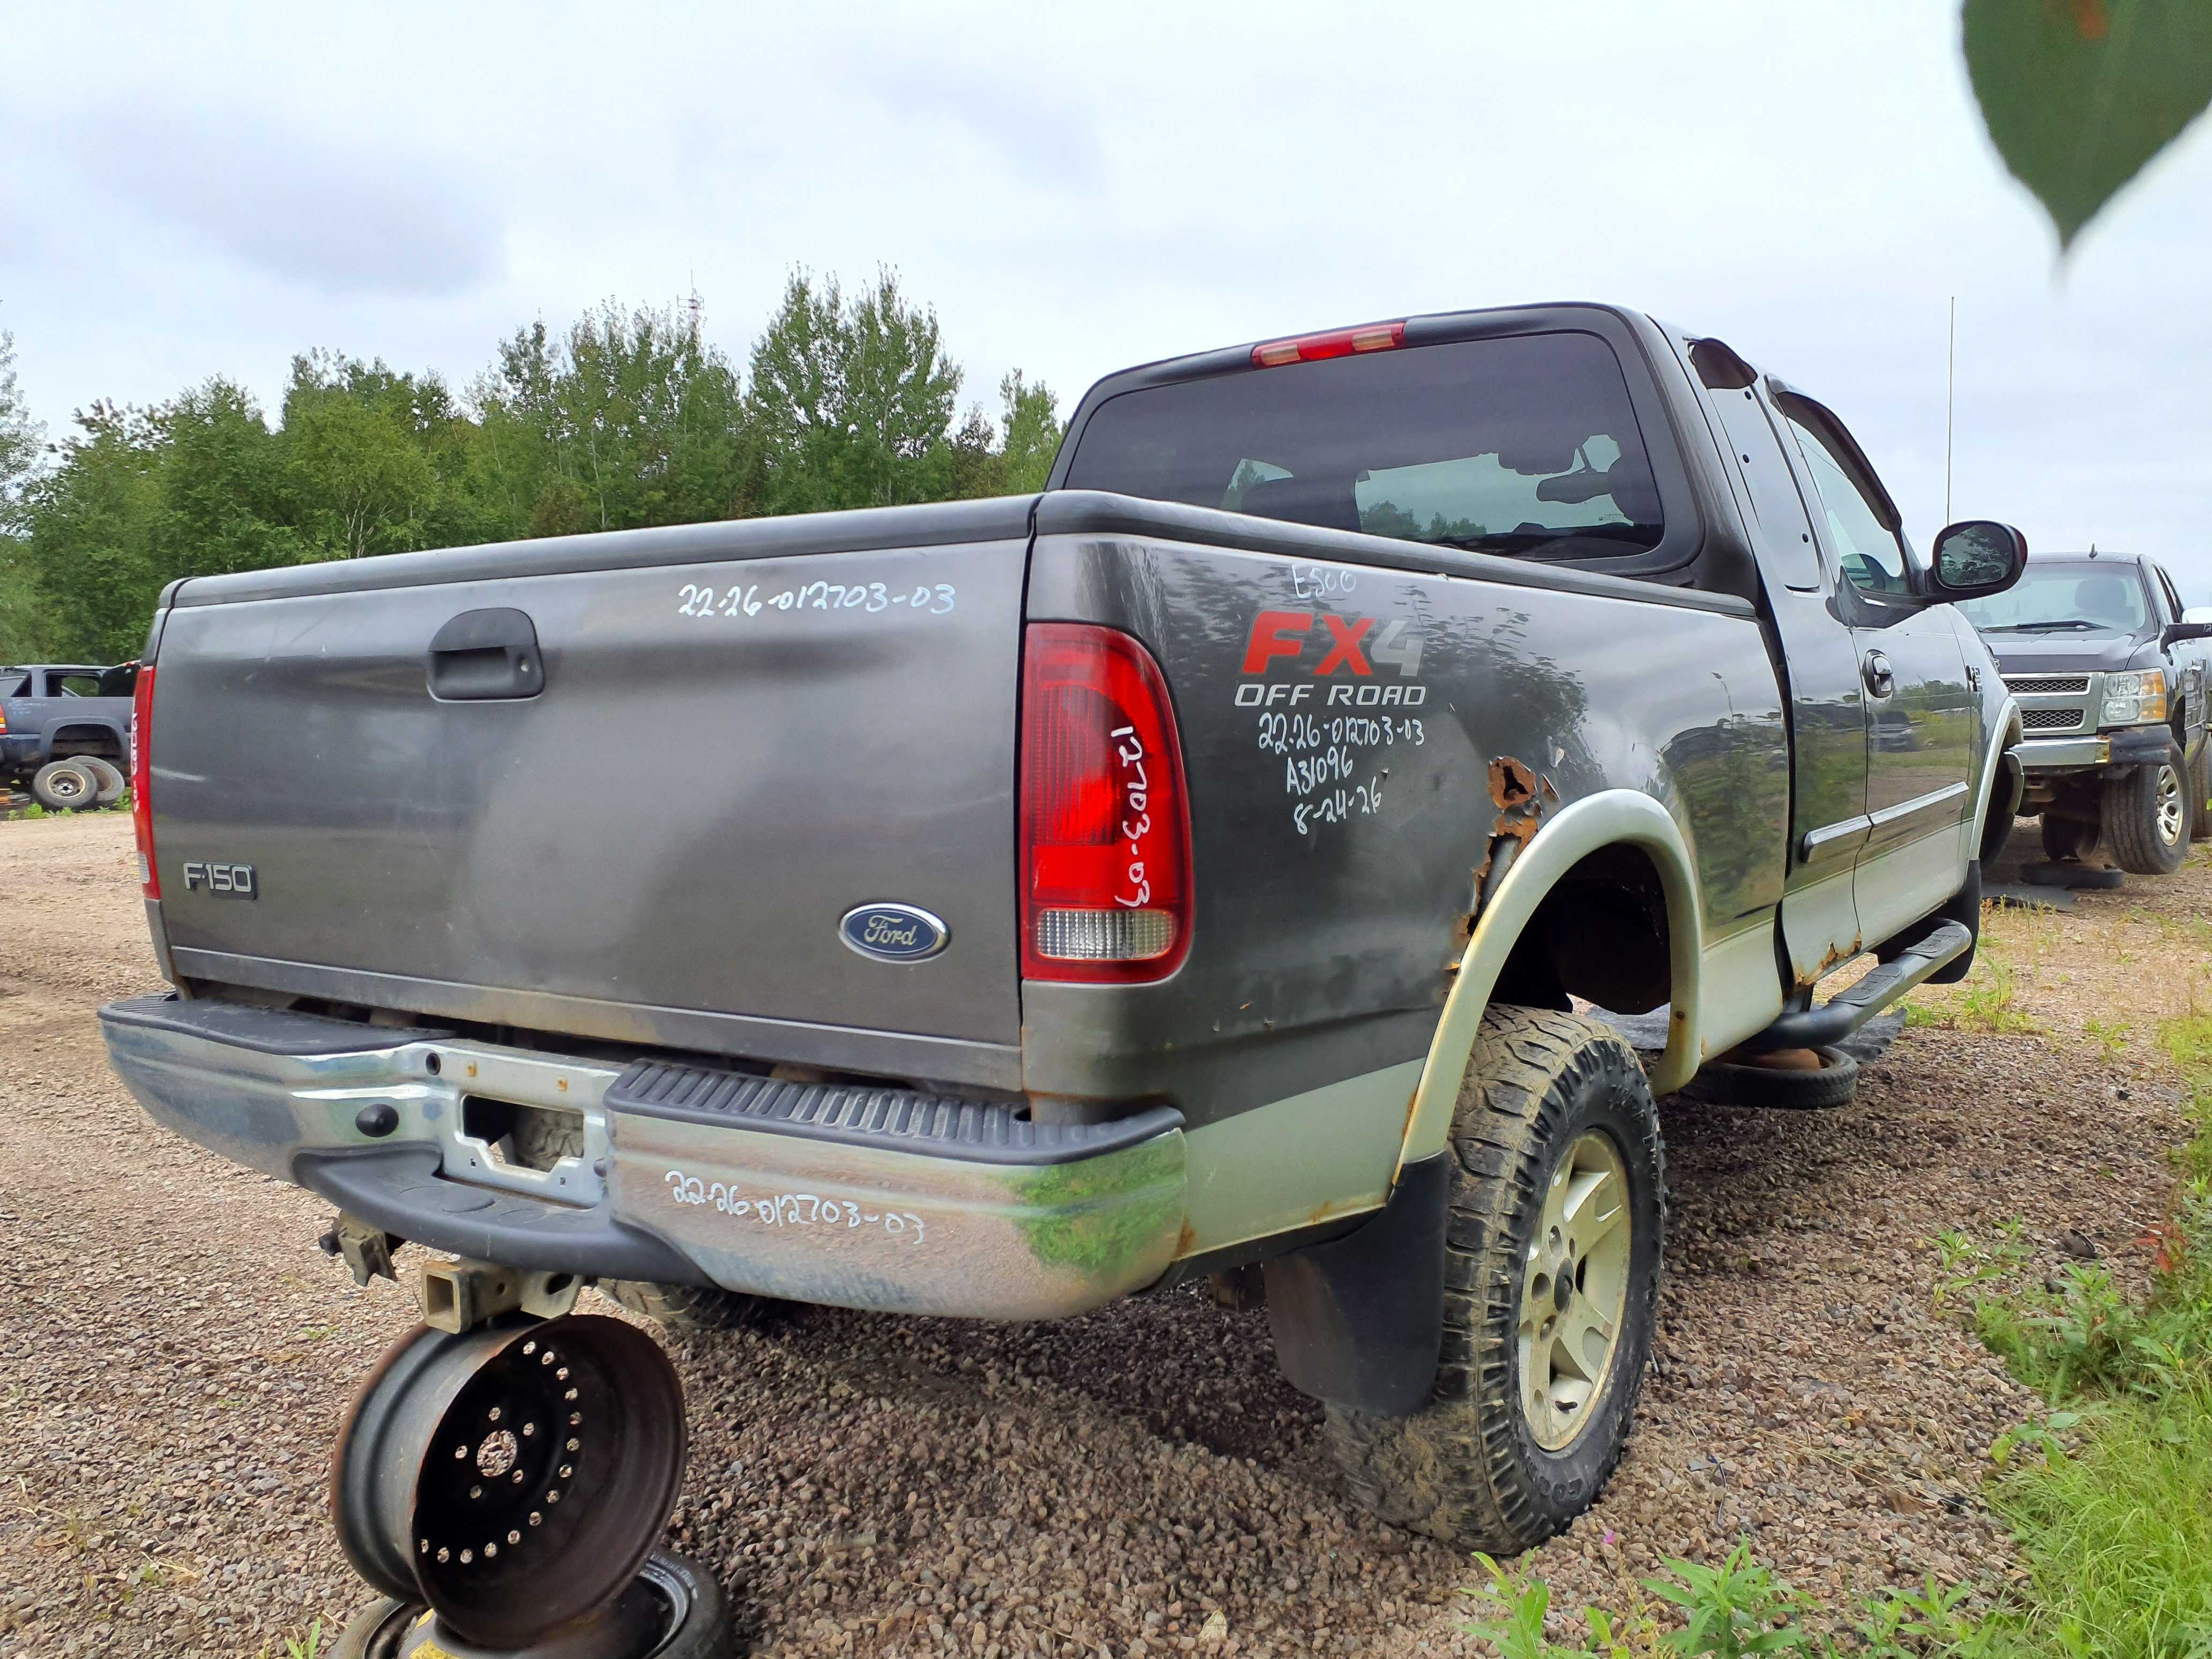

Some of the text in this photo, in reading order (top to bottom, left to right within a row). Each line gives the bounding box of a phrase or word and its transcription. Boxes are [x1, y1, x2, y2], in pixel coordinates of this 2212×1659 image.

[1242, 610, 1424, 676] FX4
[1234, 684, 1427, 706] OFF ROAD
[1287, 745, 1353, 796] A31096
[1111, 726, 1150, 908] 12703-03
[864, 915, 917, 946] Ford
